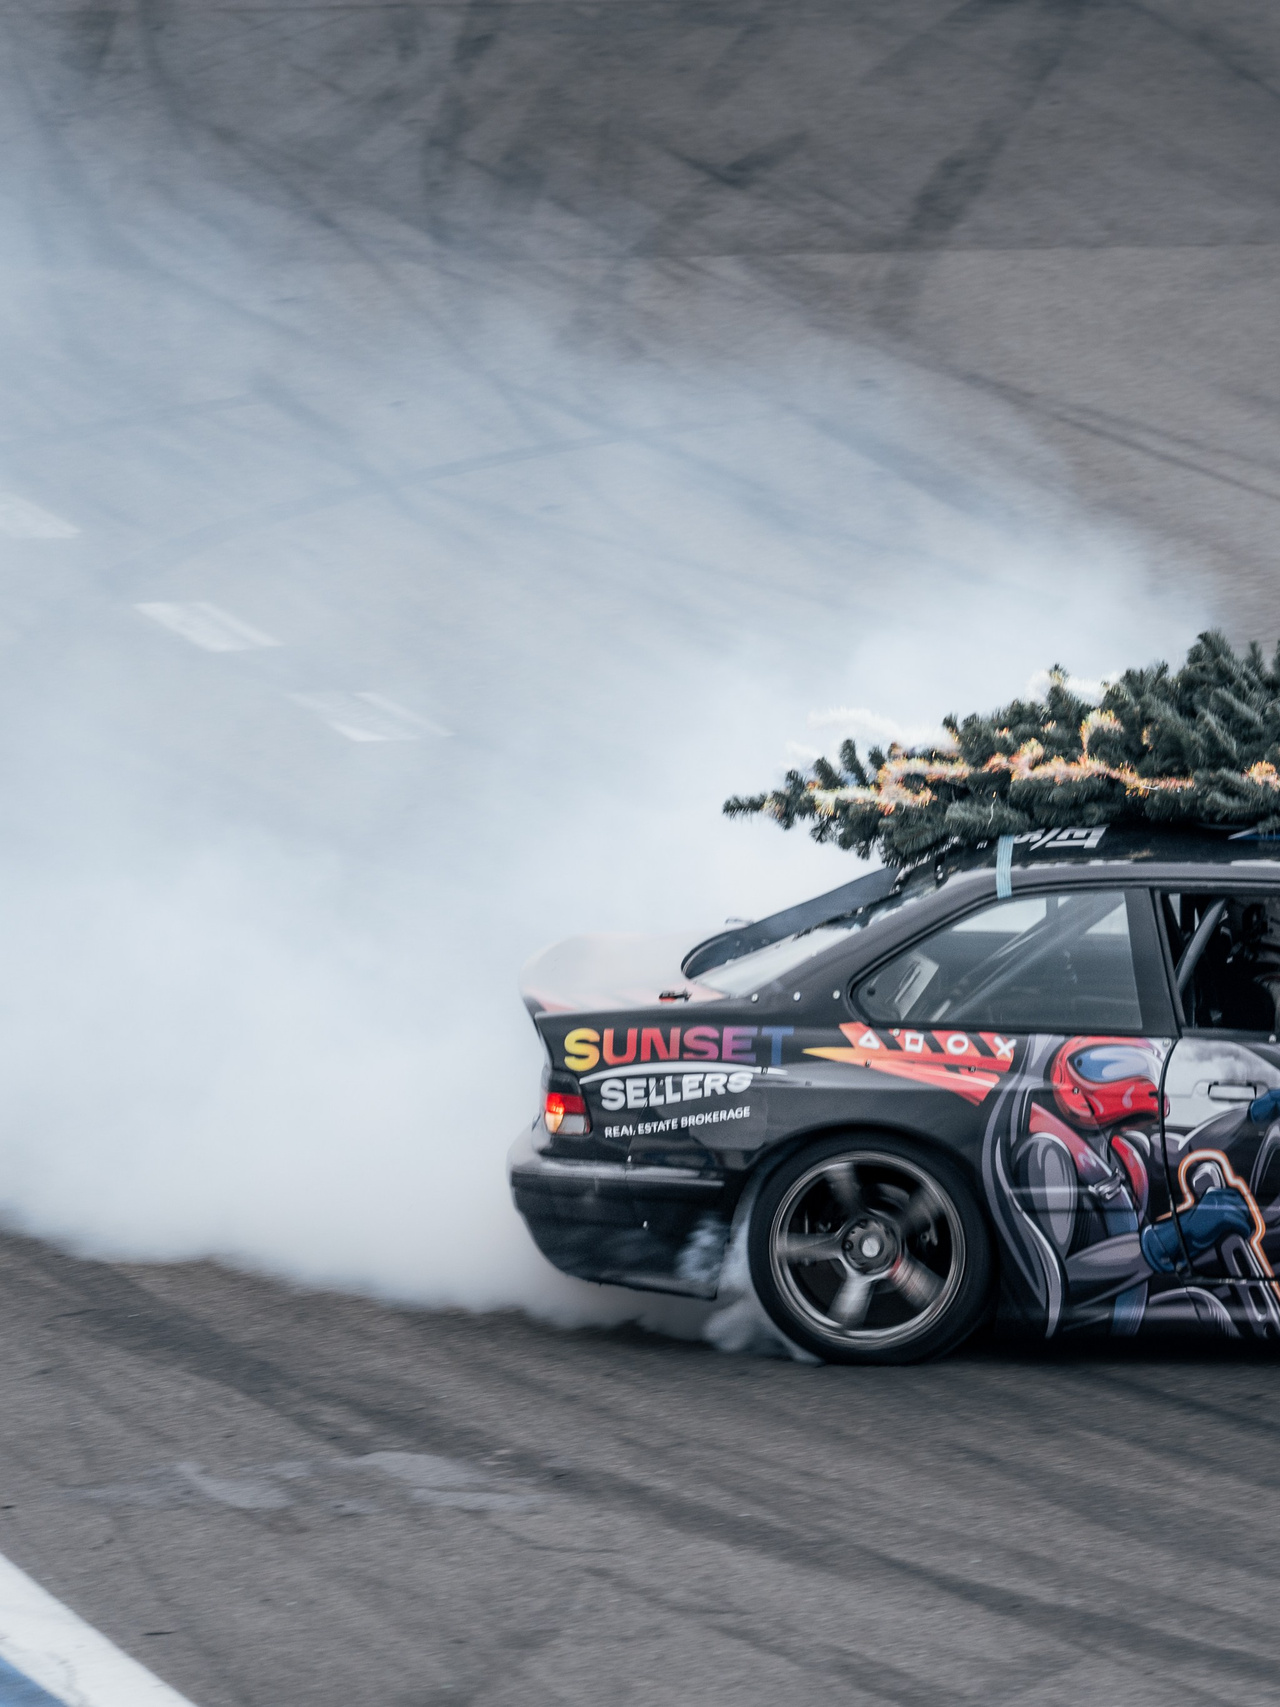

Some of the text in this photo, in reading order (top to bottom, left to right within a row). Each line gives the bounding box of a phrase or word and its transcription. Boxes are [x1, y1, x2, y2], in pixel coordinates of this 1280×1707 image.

[564, 1025, 794, 1072] SUNSET
[600, 1071, 753, 1111] SELLERS
[604, 1105, 751, 1139] REAL ESTATE BROKERAGE
